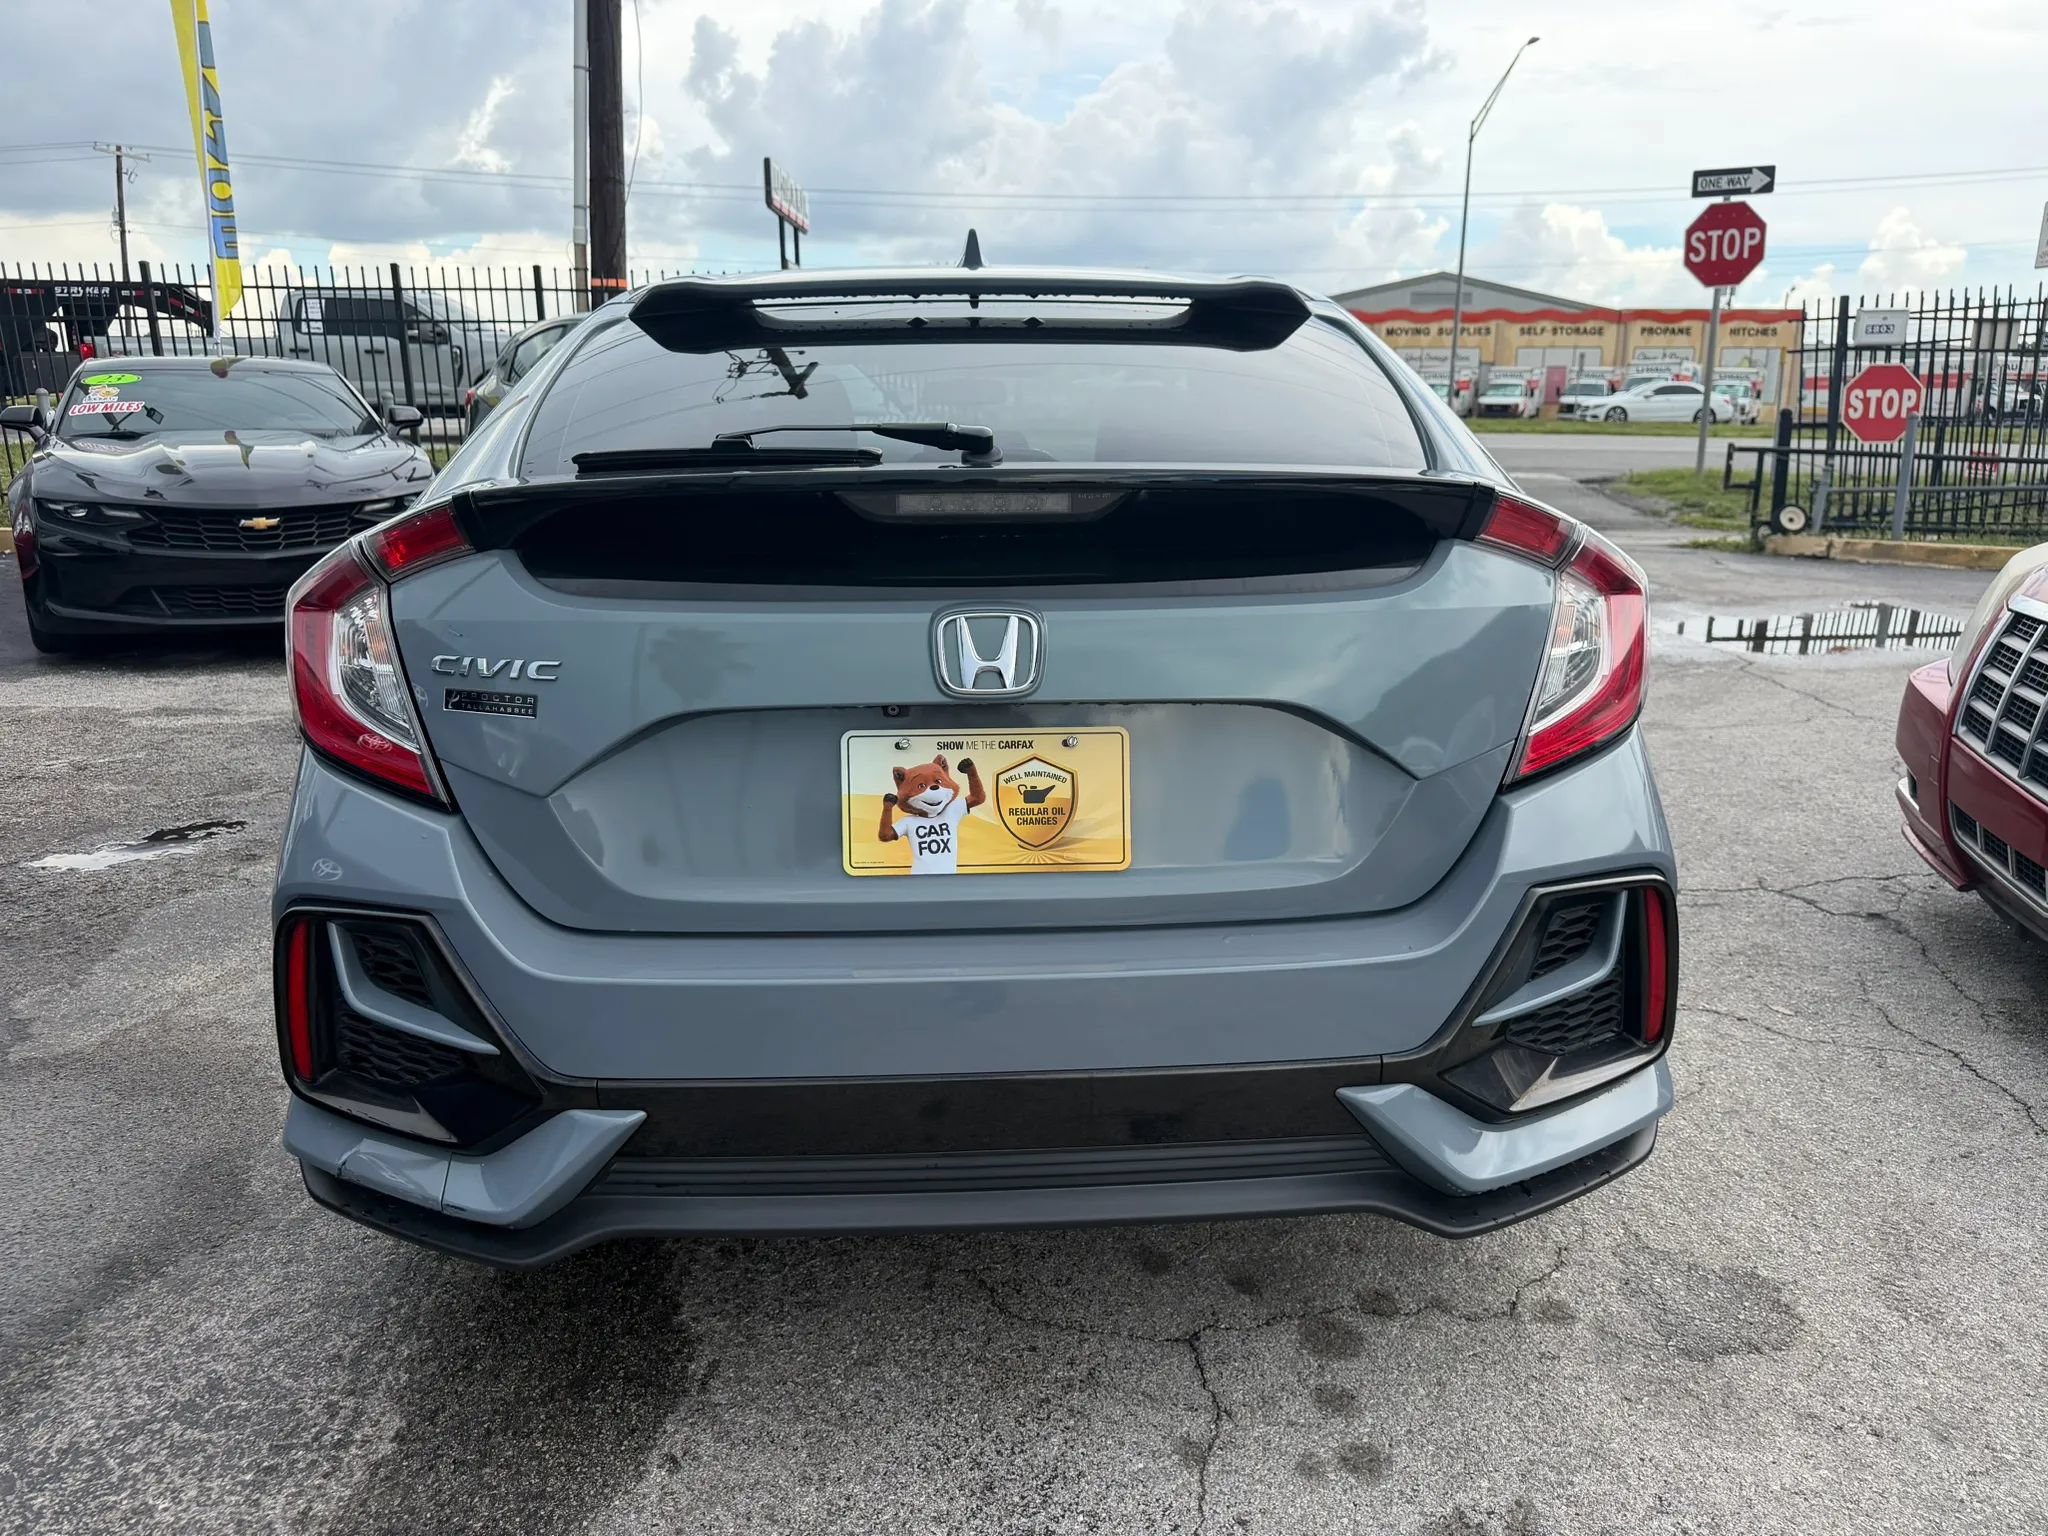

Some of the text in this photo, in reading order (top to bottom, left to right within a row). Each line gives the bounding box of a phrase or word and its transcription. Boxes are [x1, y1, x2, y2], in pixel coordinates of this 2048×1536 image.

[1700, 174, 1750, 190] ONE WAY
[1689, 226, 1761, 263] STOP
[1386, 326, 1492, 337] MOVING SUPLIES
[1640, 326, 1693, 337] PROPANE
[1729, 327, 1778, 337] HITCHES
[69, 402, 145, 416] LOW MILES
[1847, 388, 1917, 420] STOP
[431, 654, 562, 681] CIVIC
[461, 691, 534, 705] PROCTOR
[461, 703, 534, 715] TALLAHASSEE
[936, 739, 1034, 751] SHOW ME THE CARFAX
[1003, 770, 1068, 785] WELL MAINTAINED
[1009, 807, 1066, 816] REGULAR OIL
[1016, 816, 1058, 826] CHANGES
[915, 822, 951, 839] CAR
[918, 837, 952, 856] FOX
